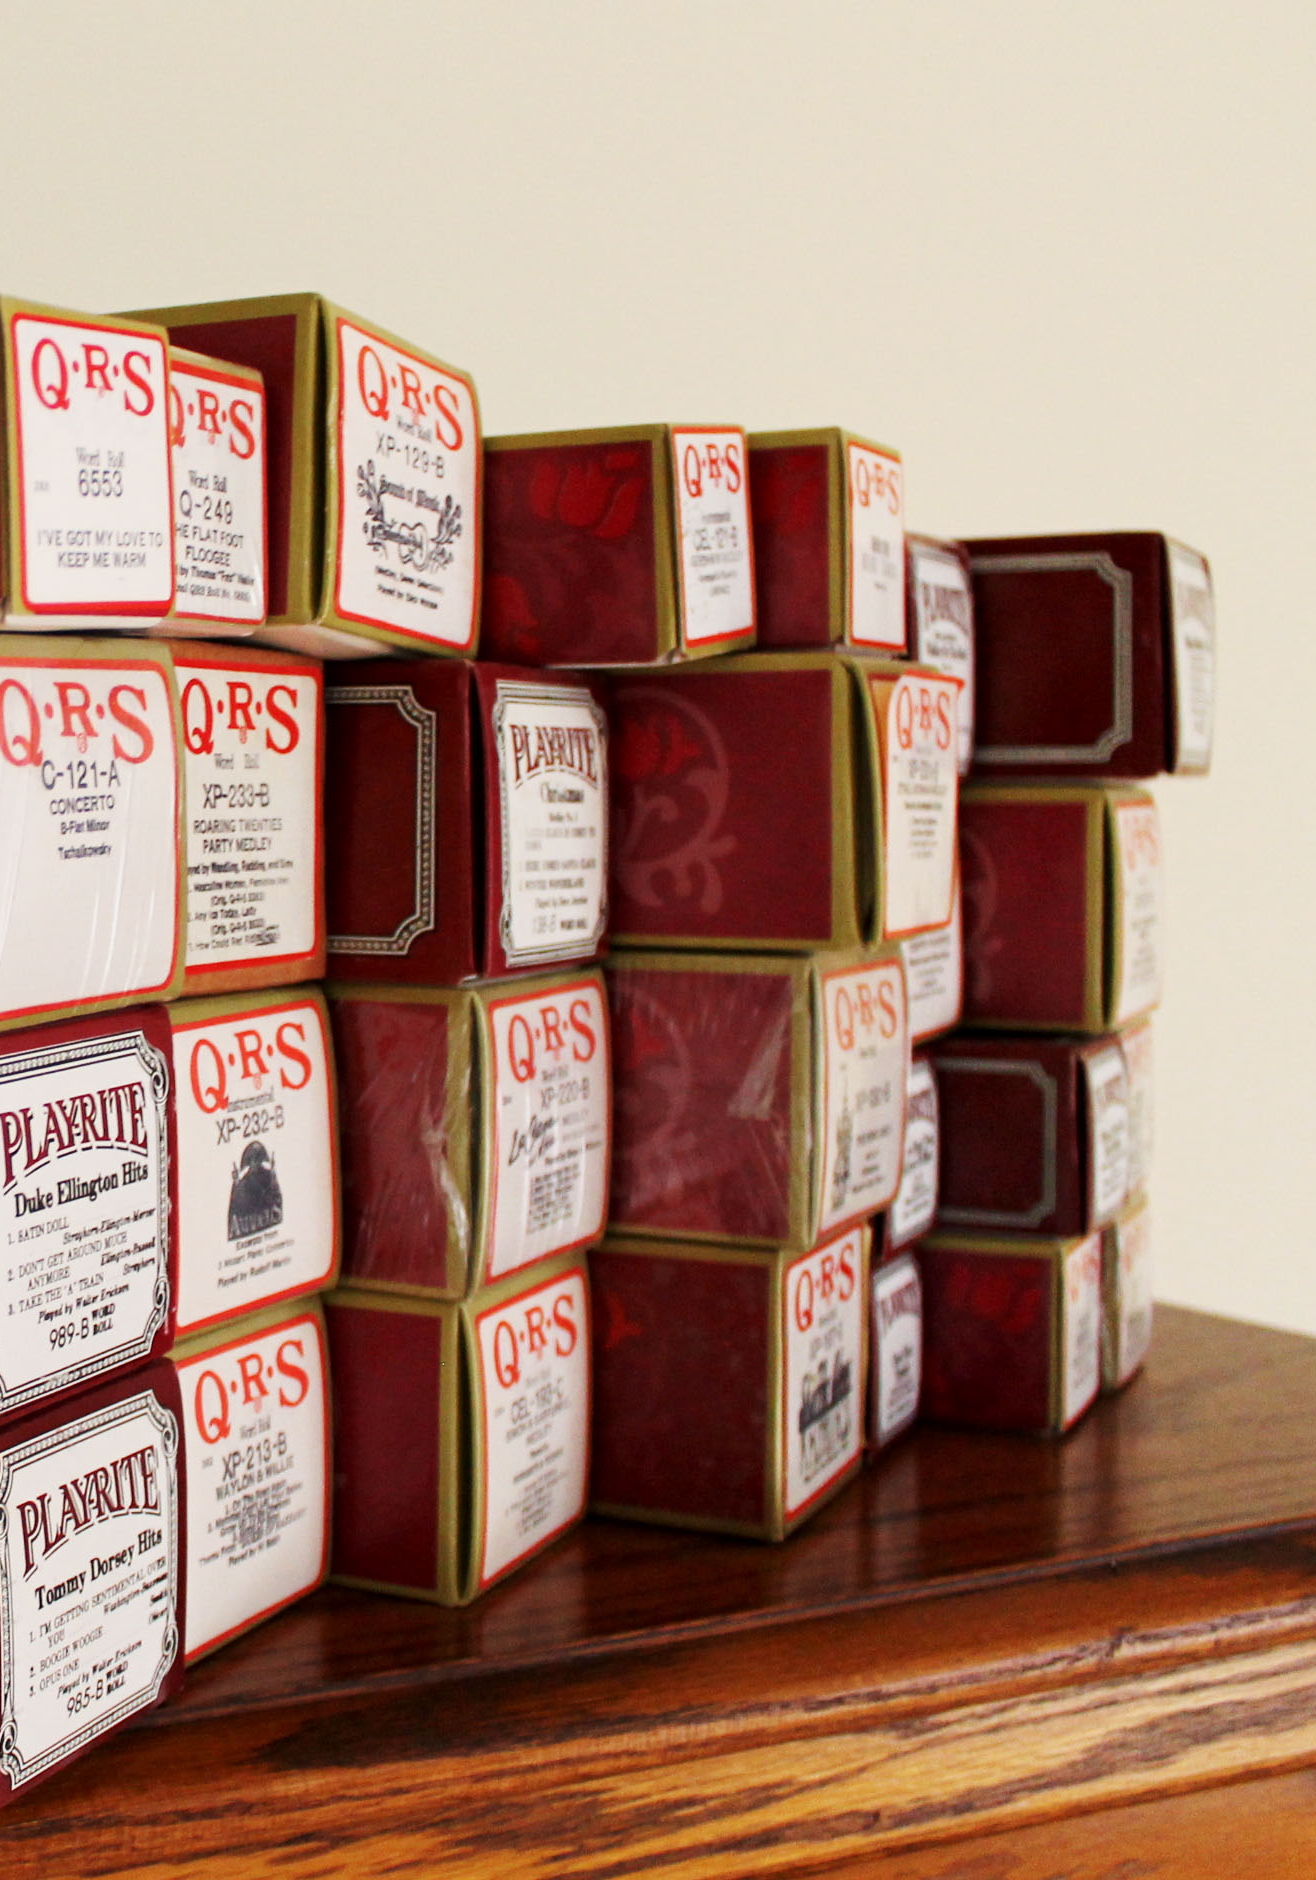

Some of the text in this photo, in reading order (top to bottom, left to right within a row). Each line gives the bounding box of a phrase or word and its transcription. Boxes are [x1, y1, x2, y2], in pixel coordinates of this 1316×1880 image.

[78, 468, 124, 497] 6553
[66, 530, 92, 548] GOT
[95, 530, 113, 548] MY
[116, 530, 146, 548] LOVE
[149, 531, 164, 548] TO
[192, 526, 244, 549] FLAT FOOT
[58, 551, 146, 568] KEEP ME WARM
[41, 760, 121, 790] C-121-A
[50, 794, 115, 815] CONCERTO
[202, 783, 270, 809] XP-233-B
[193, 818, 283, 834] ROARING TWENTIES
[203, 837, 273, 854] PARTY MEDLEY
[216, 1105, 285, 1146] XP-232-B
[14, 1161, 149, 1218] Duke Ellington Hits
[18, 1223, 45, 1243] SATIN
[47, 1216, 70, 1234] DOLL
[47, 1252, 64, 1267] GET
[67, 1240, 102, 1261] AROUND
[104, 1231, 128, 1250] MUCH
[18, 1293, 43, 1313] TAKE
[45, 1286, 63, 1303] THE
[78, 1272, 104, 1291] TRAIN
[27, 1265, 71, 1291] ANYMORE
[38, 1307, 63, 1325] Played
[65, 1305, 73, 1316] by
[75, 1293, 99, 1309] Walter
[91, 1303, 116, 1320] WORD
[49, 1317, 90, 1351] 989-B
[222, 1431, 287, 1482] XP-213-B
[216, 1473, 255, 1501] WAYLON
[265, 1454, 294, 1479] WILLIE
[35, 1528, 162, 1610] Tommy Dorsey Hits
[54, 1601, 89, 1629] GETTING
[92, 1573, 146, 1608] SENTIMENTAL
[40, 1646, 70, 1673] BOOGIE
[72, 1626, 103, 1653] WOOGIE
[47, 1629, 66, 1648] YOU
[39, 1670, 61, 1691] OPUS
[62, 1659, 80, 1677] ONE
[57, 1679, 81, 1699] Played
[82, 1673, 90, 1684] by
[67, 1679, 103, 1718] 985-B
